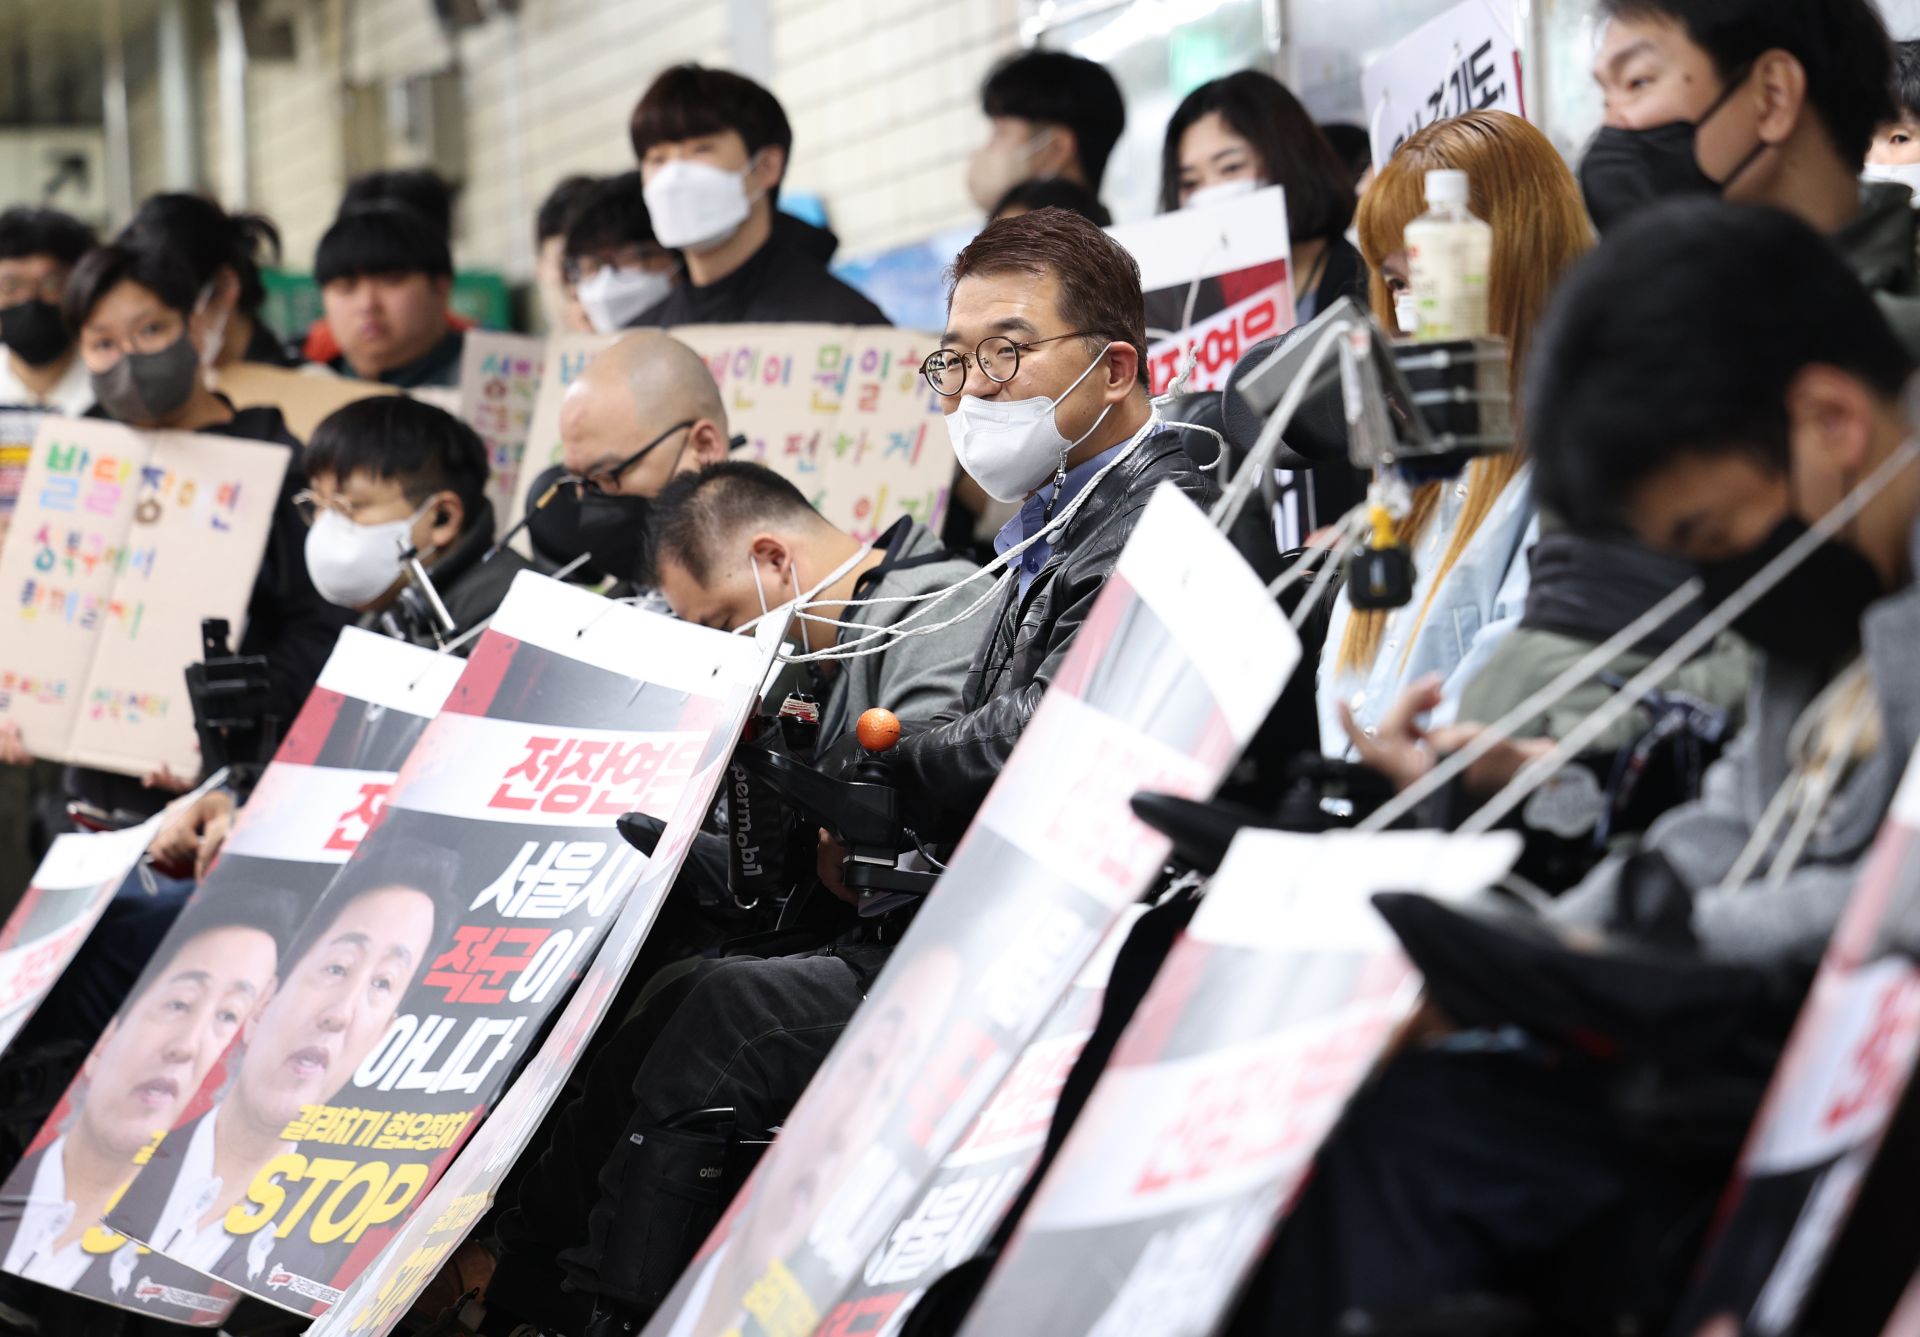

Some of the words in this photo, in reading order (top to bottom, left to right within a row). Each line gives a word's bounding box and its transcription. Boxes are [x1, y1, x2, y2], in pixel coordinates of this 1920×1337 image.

[730, 758, 764, 876] permobil
[422, 925, 595, 1005] 적군이
[353, 1013, 529, 1095] 아니다
[280, 1104, 391, 1147] 갈라치기
[371, 1110, 474, 1151] 혐오정치
[223, 1153, 430, 1244] STOP
